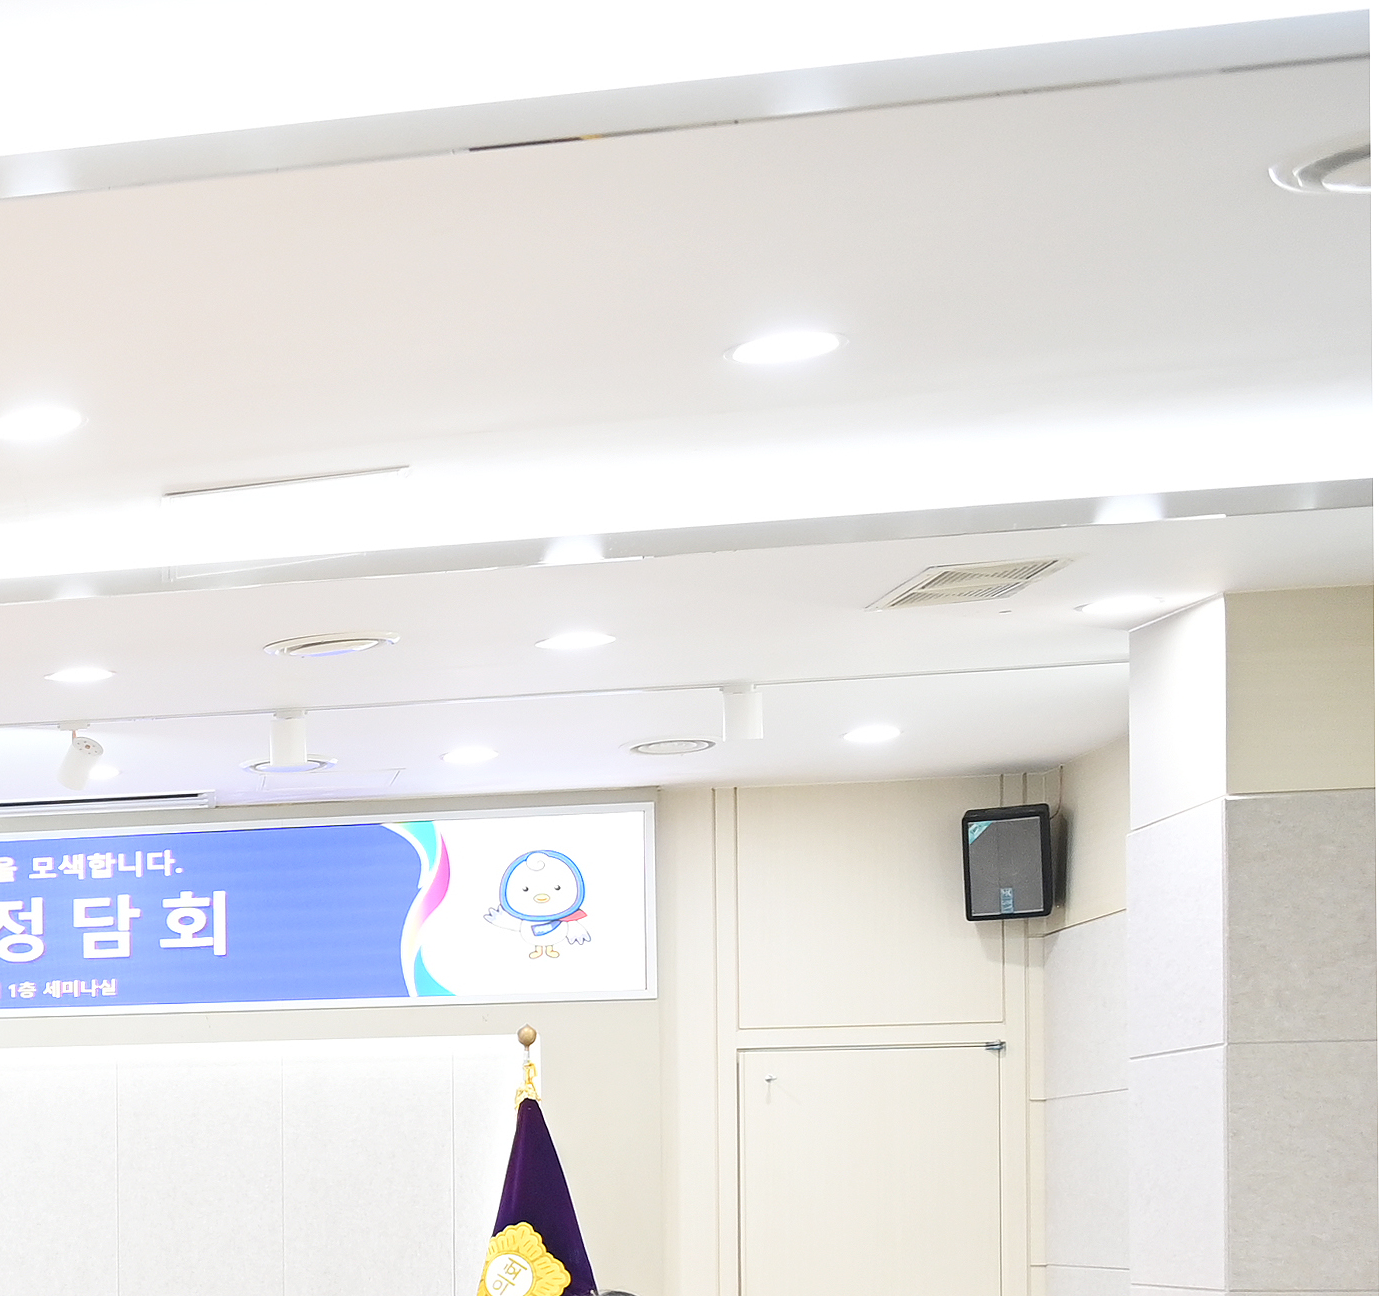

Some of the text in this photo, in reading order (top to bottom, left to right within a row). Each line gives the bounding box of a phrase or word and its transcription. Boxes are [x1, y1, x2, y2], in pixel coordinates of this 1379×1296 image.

[28, 849, 184, 880] 모색합니다.
[8, 981, 37, 999] 1층
[42, 978, 118, 999] 세미나실
